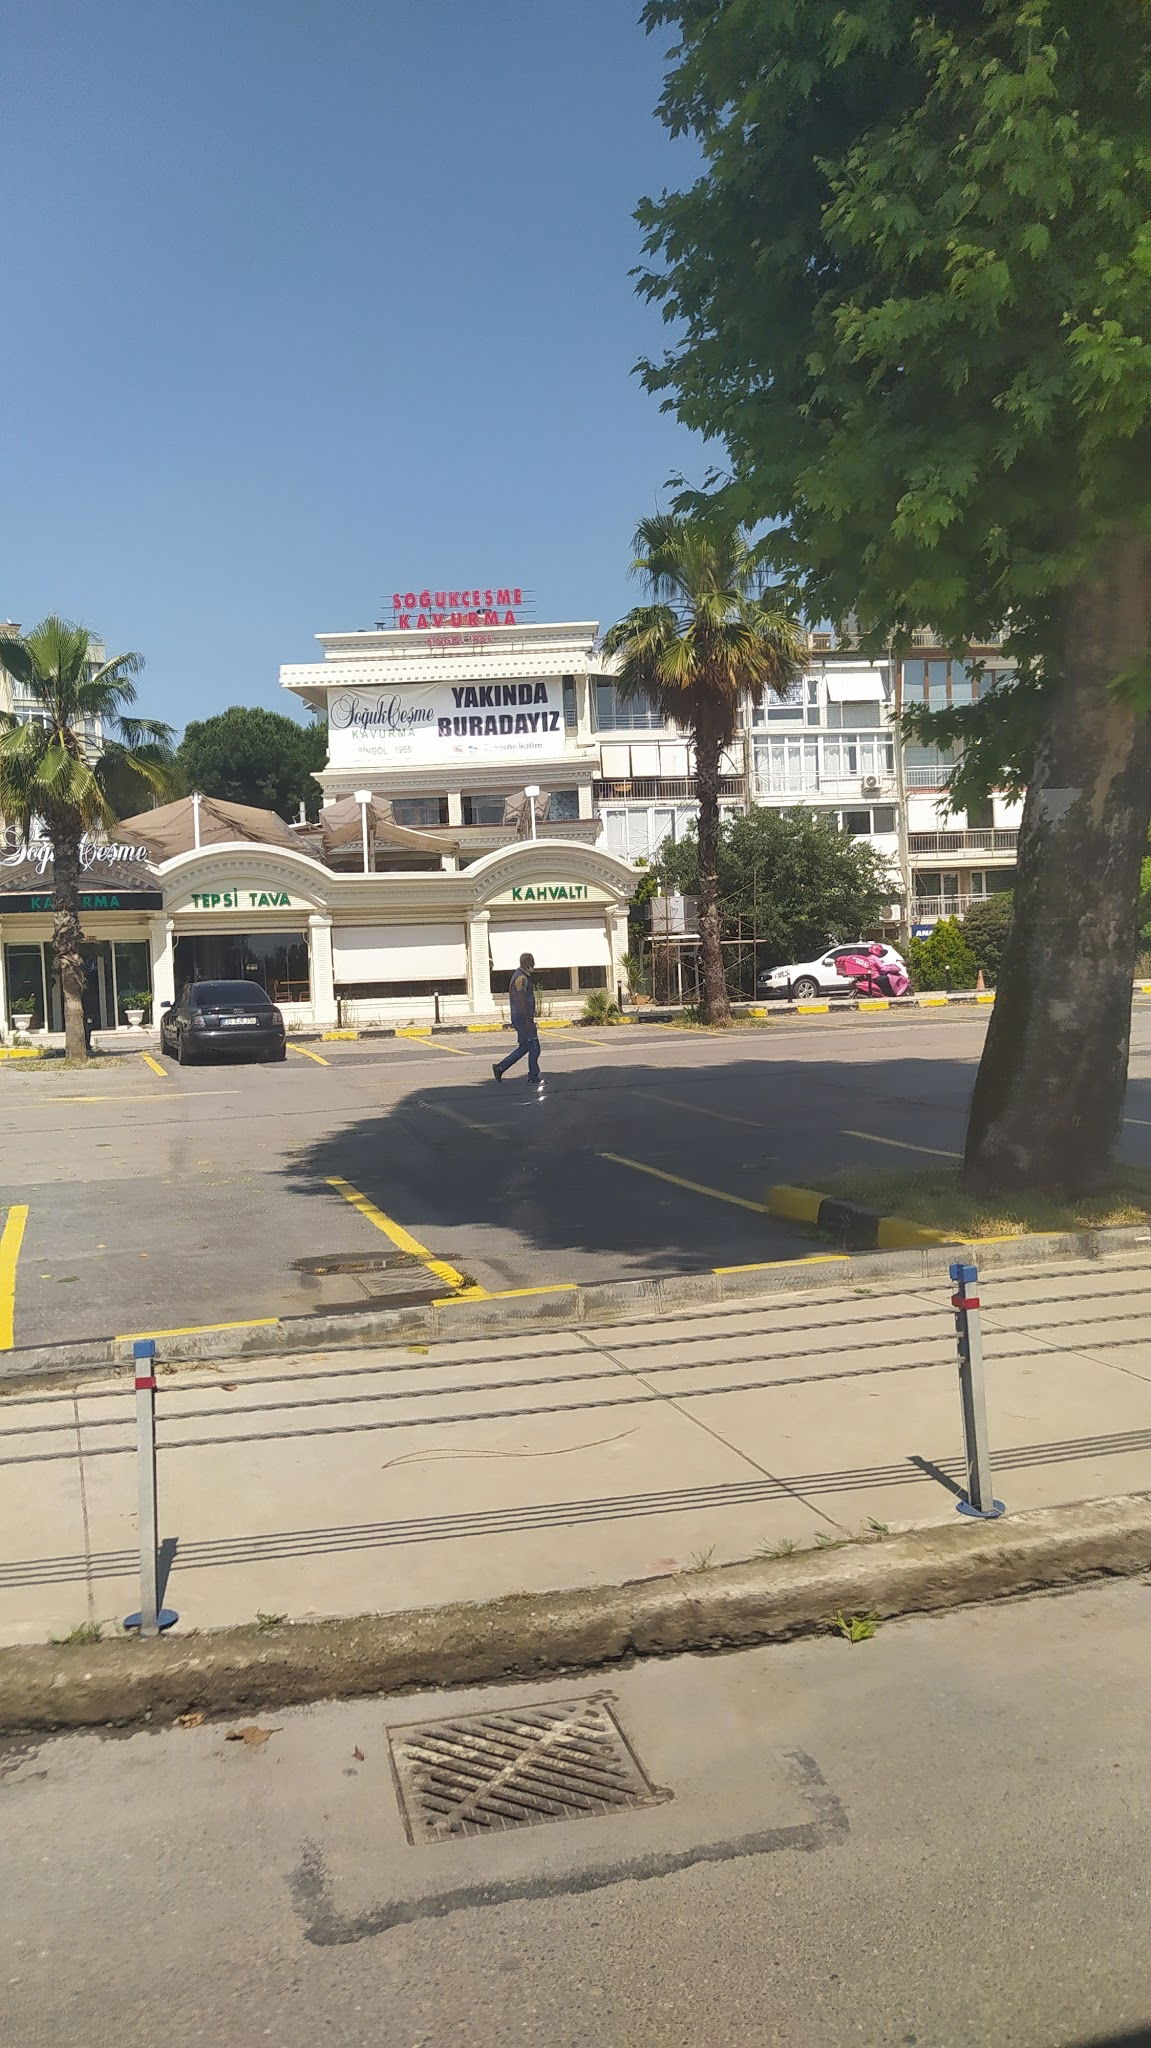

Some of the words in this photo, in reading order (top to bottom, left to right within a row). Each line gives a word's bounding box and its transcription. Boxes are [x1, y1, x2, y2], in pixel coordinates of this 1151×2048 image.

[398, 610, 516, 629] KAVURMA
[451, 682, 549, 708] YAKINDA
[437, 710, 561, 737] BURADAYIZ
[351, 728, 416, 740] KAVURMA
[31, 895, 121, 909] KARMA
[191, 887, 239, 909] TEPSİ
[248, 892, 292, 908] TAVA
[511, 885, 588, 902] KAHVALTI
